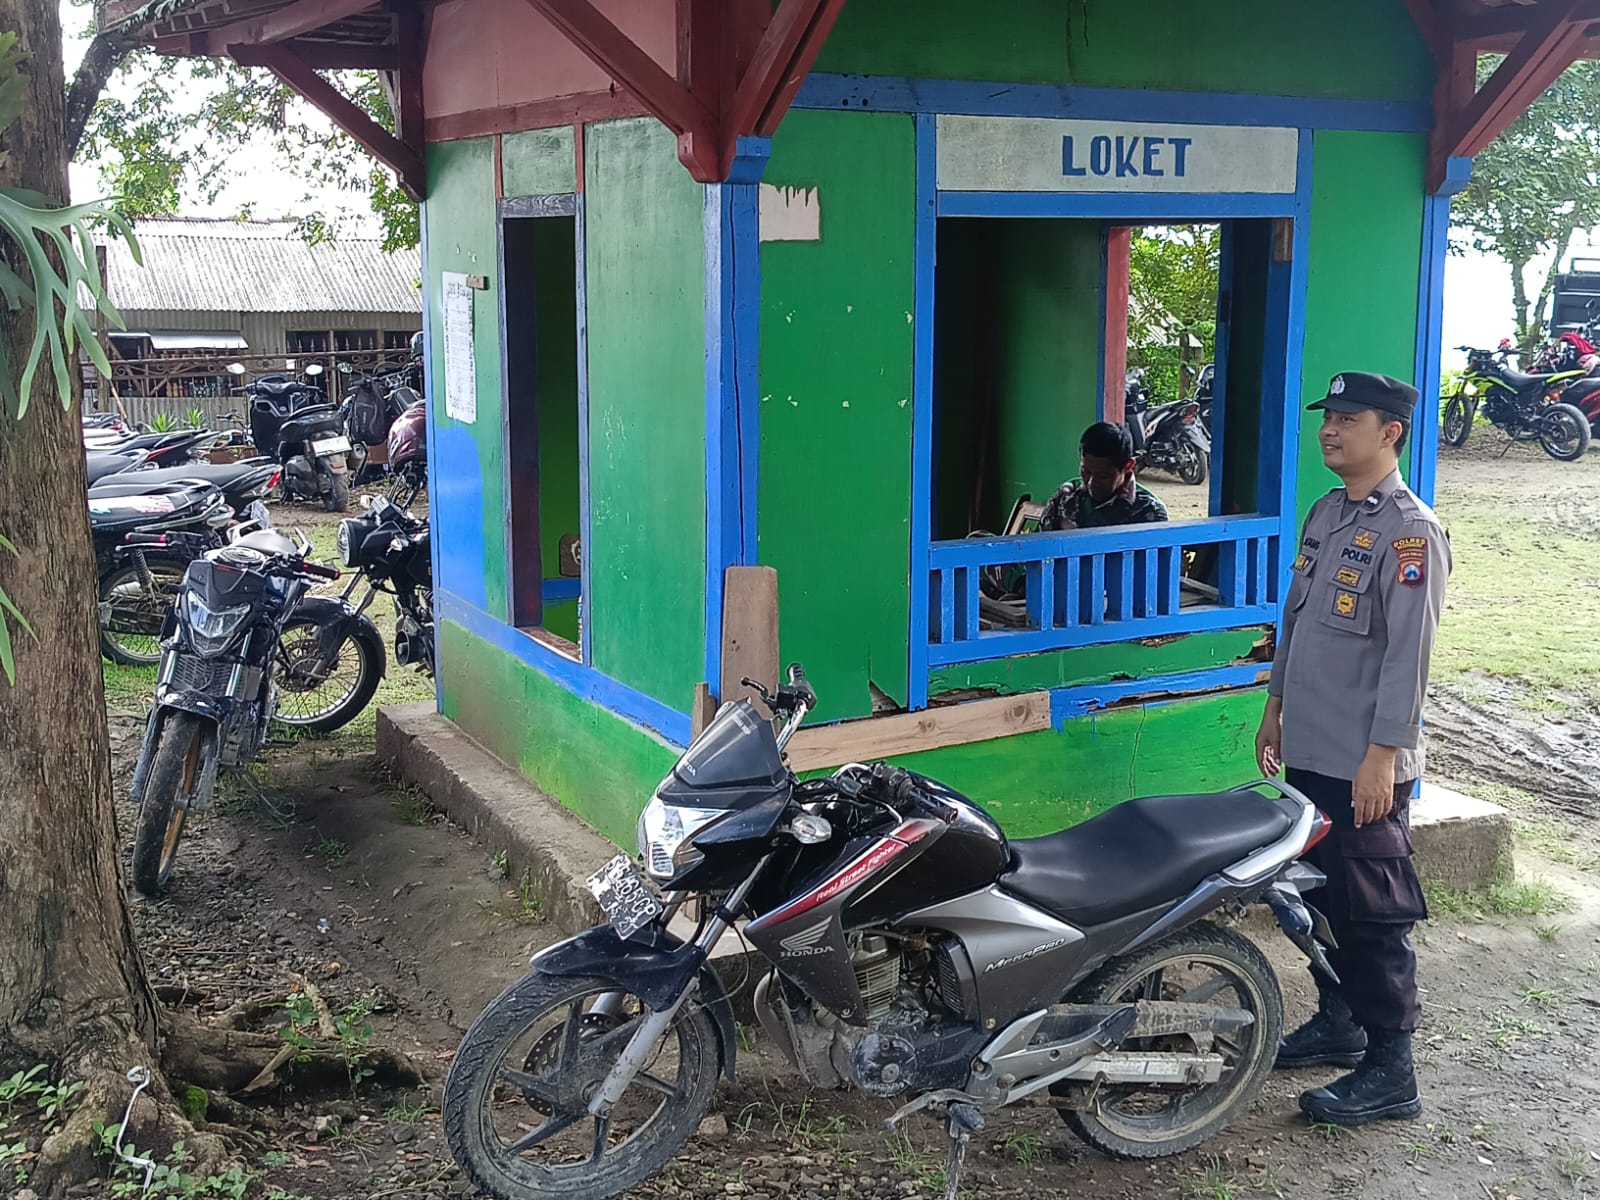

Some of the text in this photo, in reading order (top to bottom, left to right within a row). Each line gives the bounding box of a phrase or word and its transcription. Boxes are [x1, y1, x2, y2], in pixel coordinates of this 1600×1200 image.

[1062, 135, 1192, 177] LOKET
[1341, 547, 1372, 565] POLRI
[780, 946, 835, 957] HONDA
